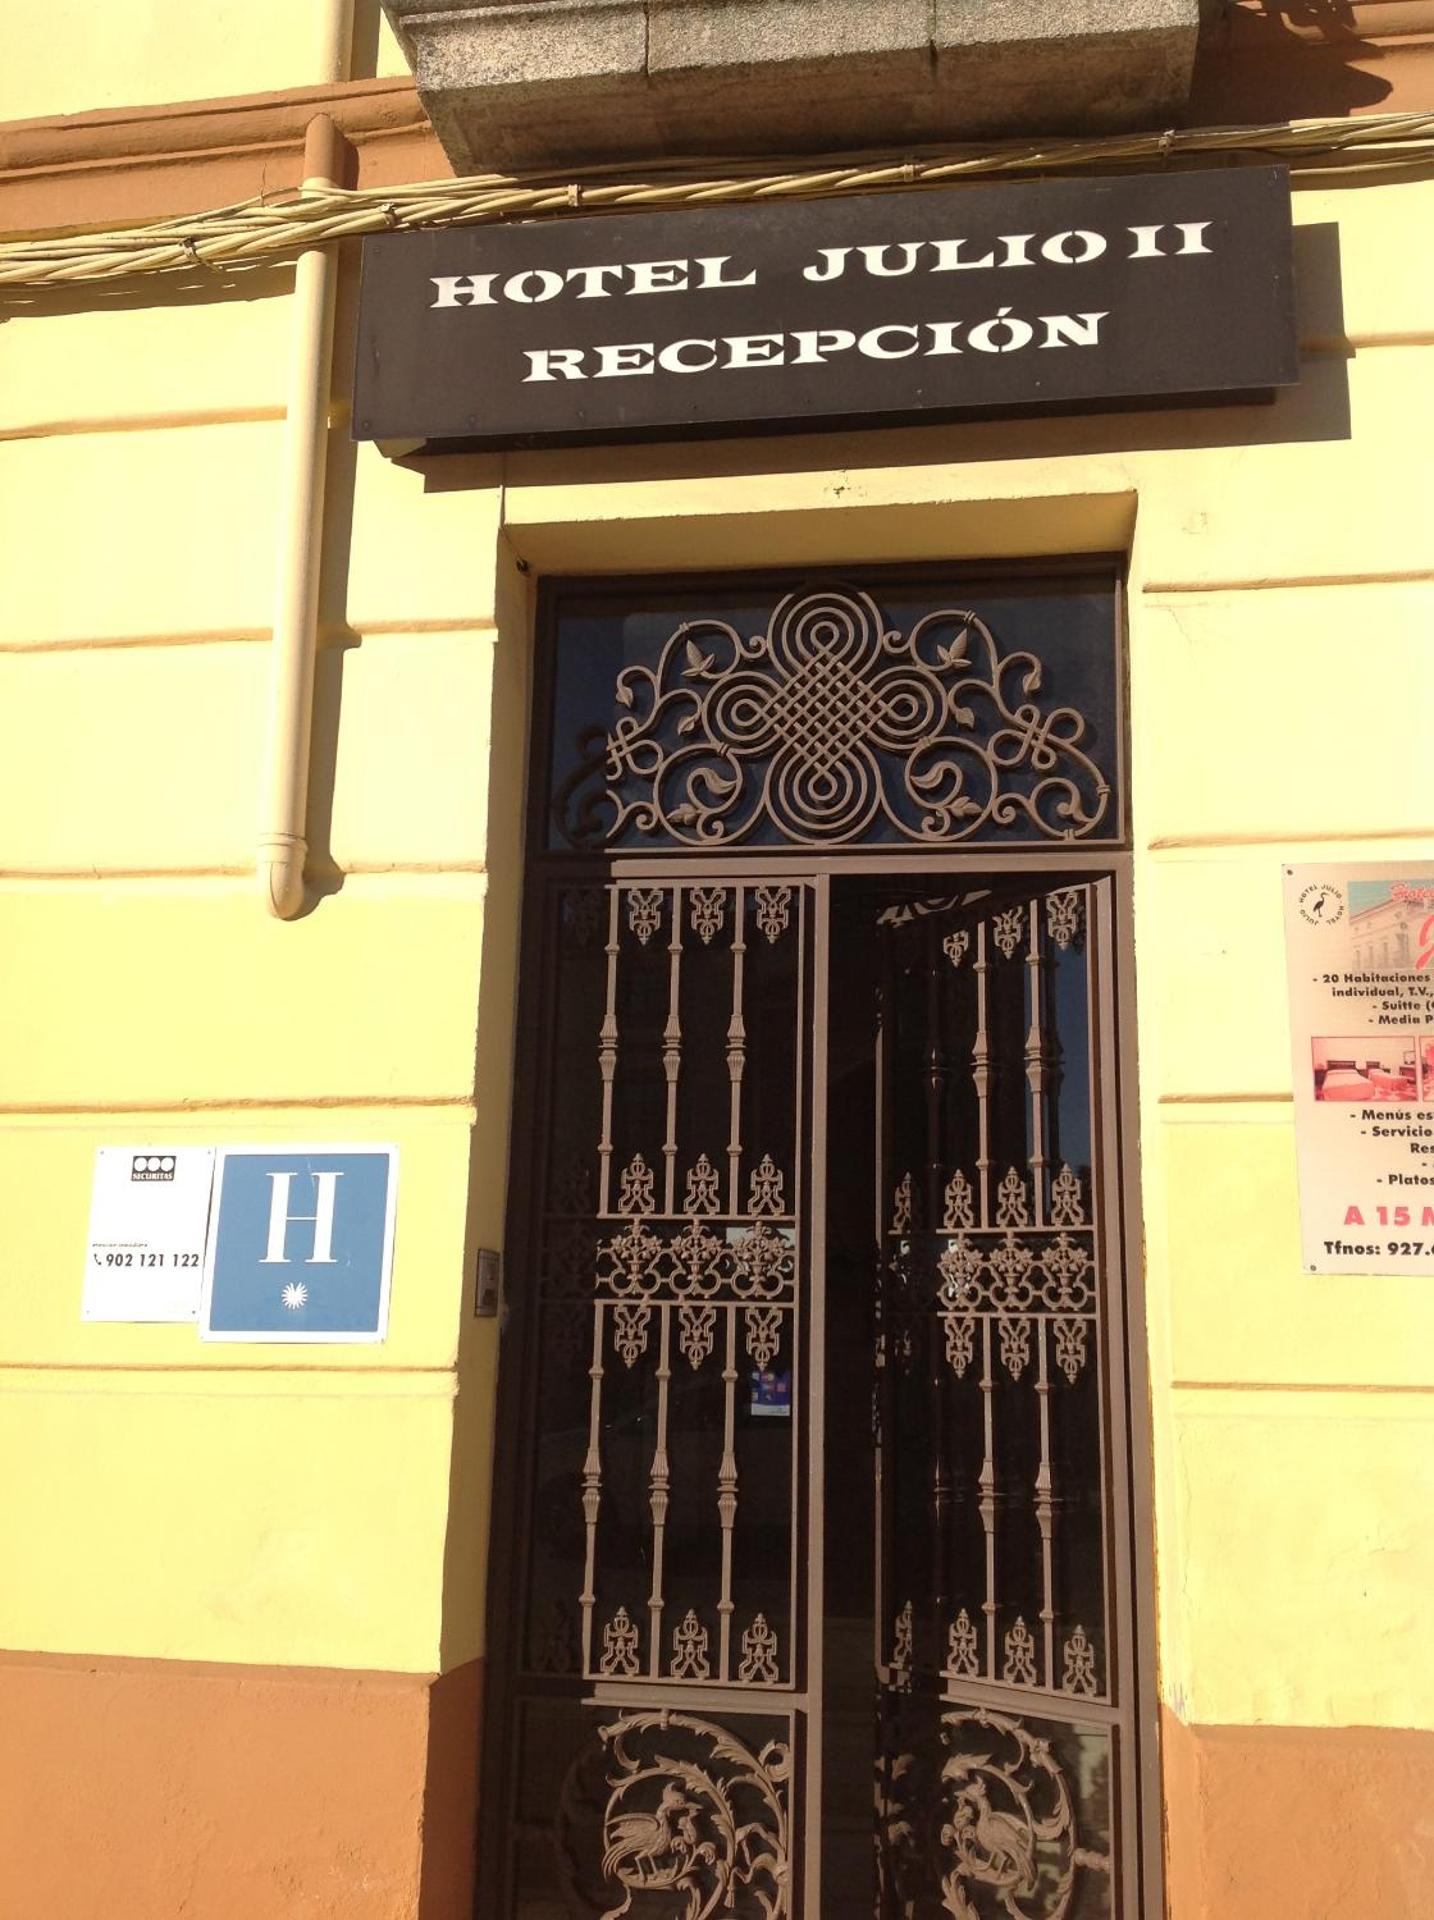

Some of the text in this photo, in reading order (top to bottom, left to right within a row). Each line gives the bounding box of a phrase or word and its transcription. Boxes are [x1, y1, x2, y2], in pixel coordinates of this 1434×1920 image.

[430, 221, 1213, 308] HOTEL JULIO II
[522, 306, 1109, 383] RECEPCIÓN
[1322, 972, 1431, 983] 20 Habitaciones
[1331, 986, 1404, 998] individual,
[1382, 1001, 1421, 1011] Suitte
[1378, 1014, 1421, 1025] Media
[1361, 1109, 1412, 1121] Menús
[1372, 1125, 1433, 1137] Servicio
[257, 1172, 344, 1263] H
[1344, 1205, 1366, 1226] A
[1376, 1206, 1411, 1226] 15
[1323, 1240, 1381, 1256] Tfnos:
[105, 1253, 200, 1268] 902 121 122
